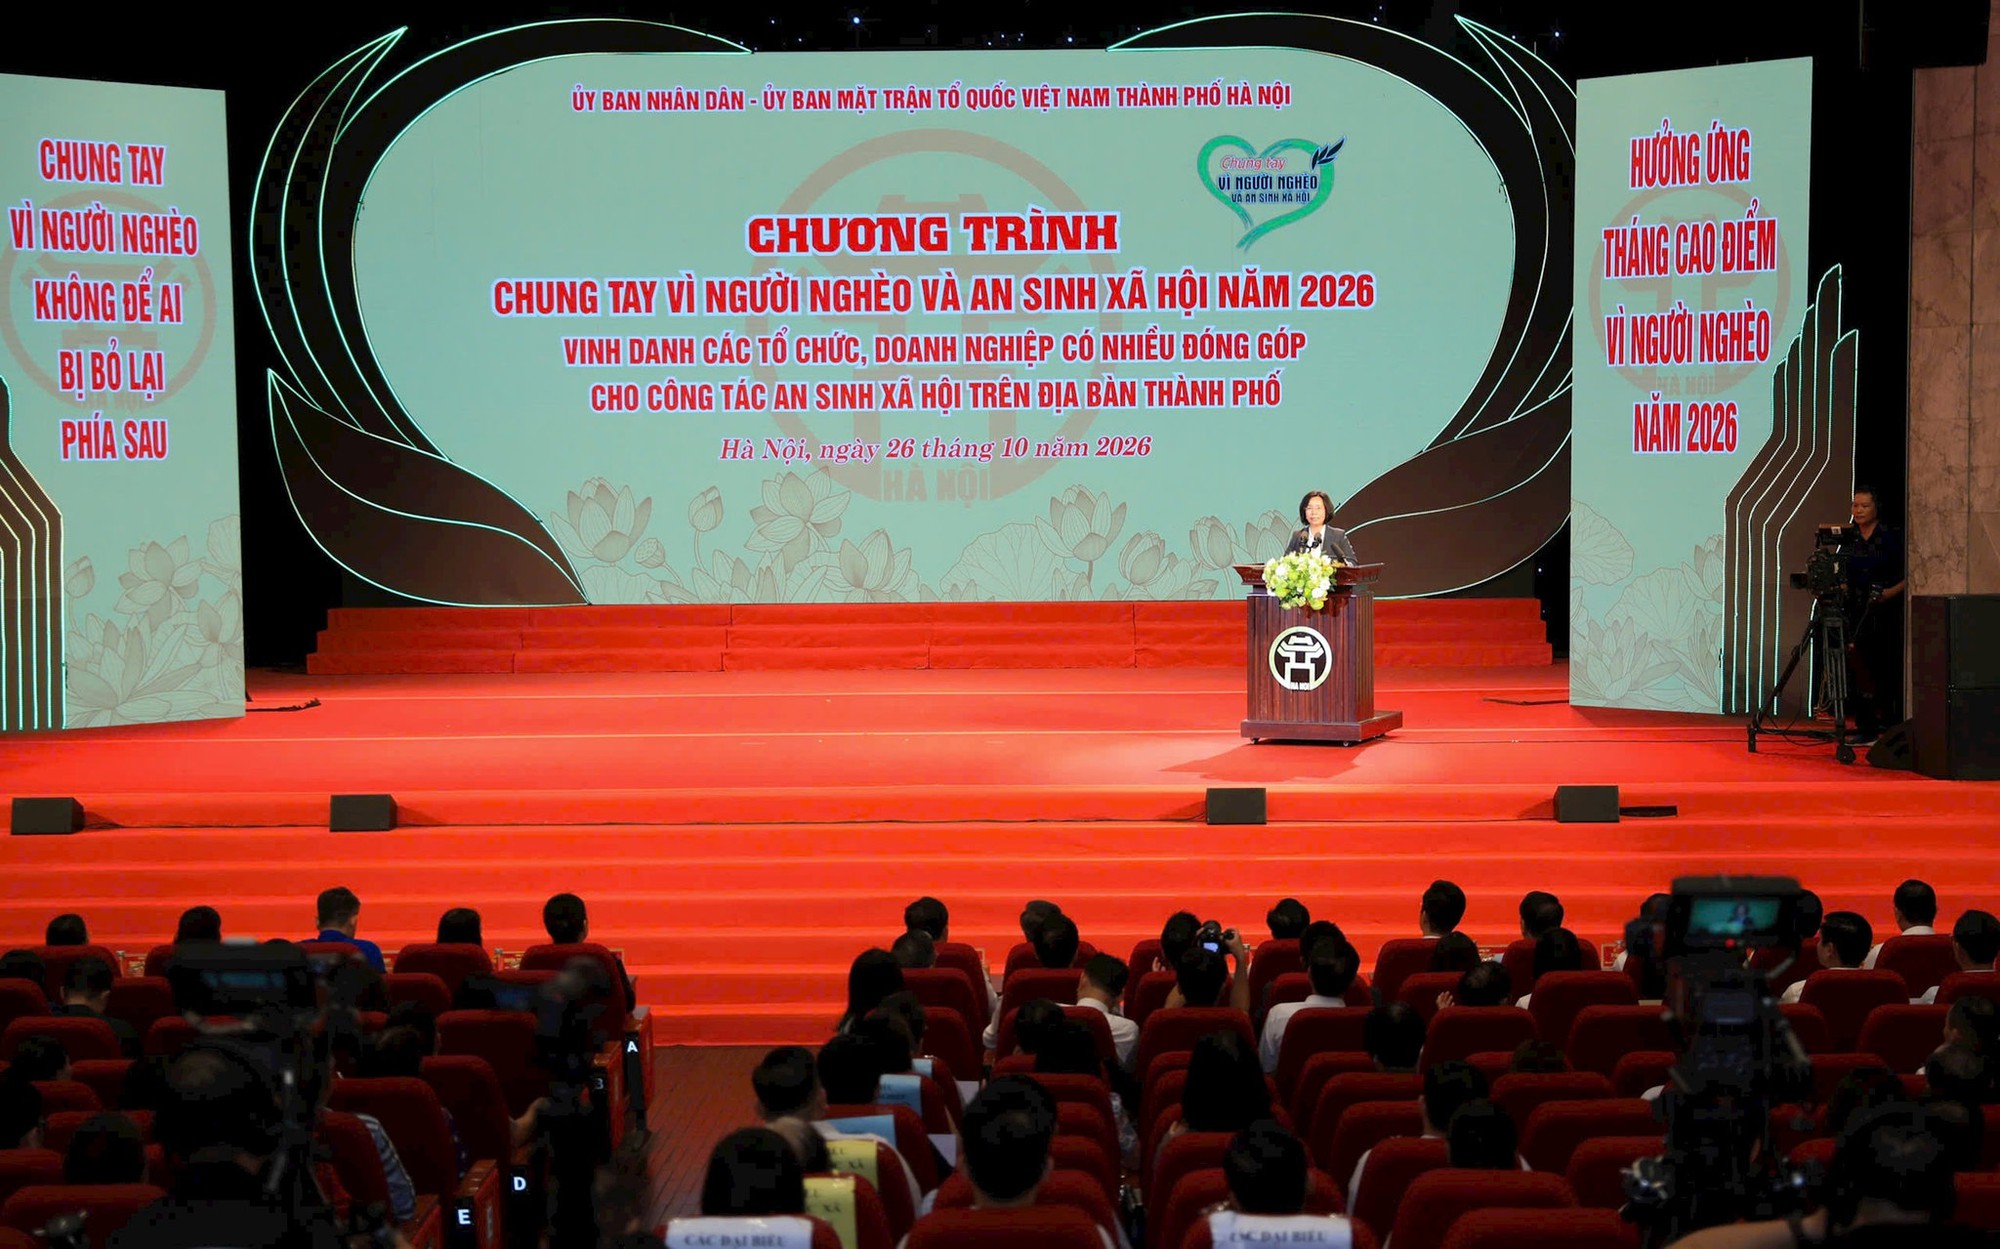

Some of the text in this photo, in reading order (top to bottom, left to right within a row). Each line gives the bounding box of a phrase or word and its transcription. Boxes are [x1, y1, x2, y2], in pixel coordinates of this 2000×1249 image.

[572, 84, 596, 112] ỦY
[602, 91, 642, 112] BAN
[646, 87, 700, 111] NHÂN
[705, 86, 745, 111] DÂN
[763, 84, 787, 111] ỦY
[792, 89, 832, 111] BAN
[836, 84, 878, 114] MẶT
[883, 85, 933, 114] TRẬN
[937, 81, 961, 109] TỔ
[965, 80, 1017, 111] QUỐC
[1021, 82, 1061, 112] VIỆT
[1066, 87, 1111, 108] NAM
[1116, 82, 1179, 107] THÀNH
[1183, 82, 1222, 107] PHỐ
[1226, 82, 1253, 106] HÀ
[1257, 81, 1292, 109] NỘI
[39, 139, 165, 186] CHUNG TAY
[1222, 157, 1286, 171] Chung tay
[1630, 119, 1751, 189] HƯỞNG ỨNG
[1218, 173, 1318, 190] VÌ NGƯỜI NGHÈO
[1245, 193, 1257, 203] AN
[1259, 193, 1279, 203] SINH
[9, 201, 199, 256] VÌ NGƯỜI NGHÈO
[748, 207, 1119, 254] CHƯƠNG TRÌNH
[1602, 198, 1777, 279] THÁNG CAO ĐIỂM
[34, 268, 182, 324] KHÔNG ĐỂ AI
[494, 266, 1375, 318] CHUNG TAY VÌ NGƯỜI NGHÈO VÀ AN SINH XÃ HỘI NĂM 2026
[563, 325, 1307, 368] VINH DANH CÁC TỔ CHỨC, DOANH NGHIỆP CÓ NHIỀU ĐÓNG GÓP
[1605, 300, 1771, 366] VÌ NGƯỜI NGHÈO
[59, 338, 165, 400] BỊ BỎ LẠI
[591, 370, 1281, 415] CHO CÔNG TÁC AN SINH XÃ HỘI TRÊN ĐỊA BÀN THÀNH PHỐ
[61, 412, 168, 460] PHÍA SAU
[1633, 393, 1738, 453] NĂM 2026
[721, 436, 1152, 465] Hà Nội, ngày 26 tháng 10 năm 2026
[883, 461, 989, 508] HÀ NỘI
[627, 1040, 639, 1053] A
[513, 1176, 527, 1191] D
[457, 1208, 471, 1225] E
